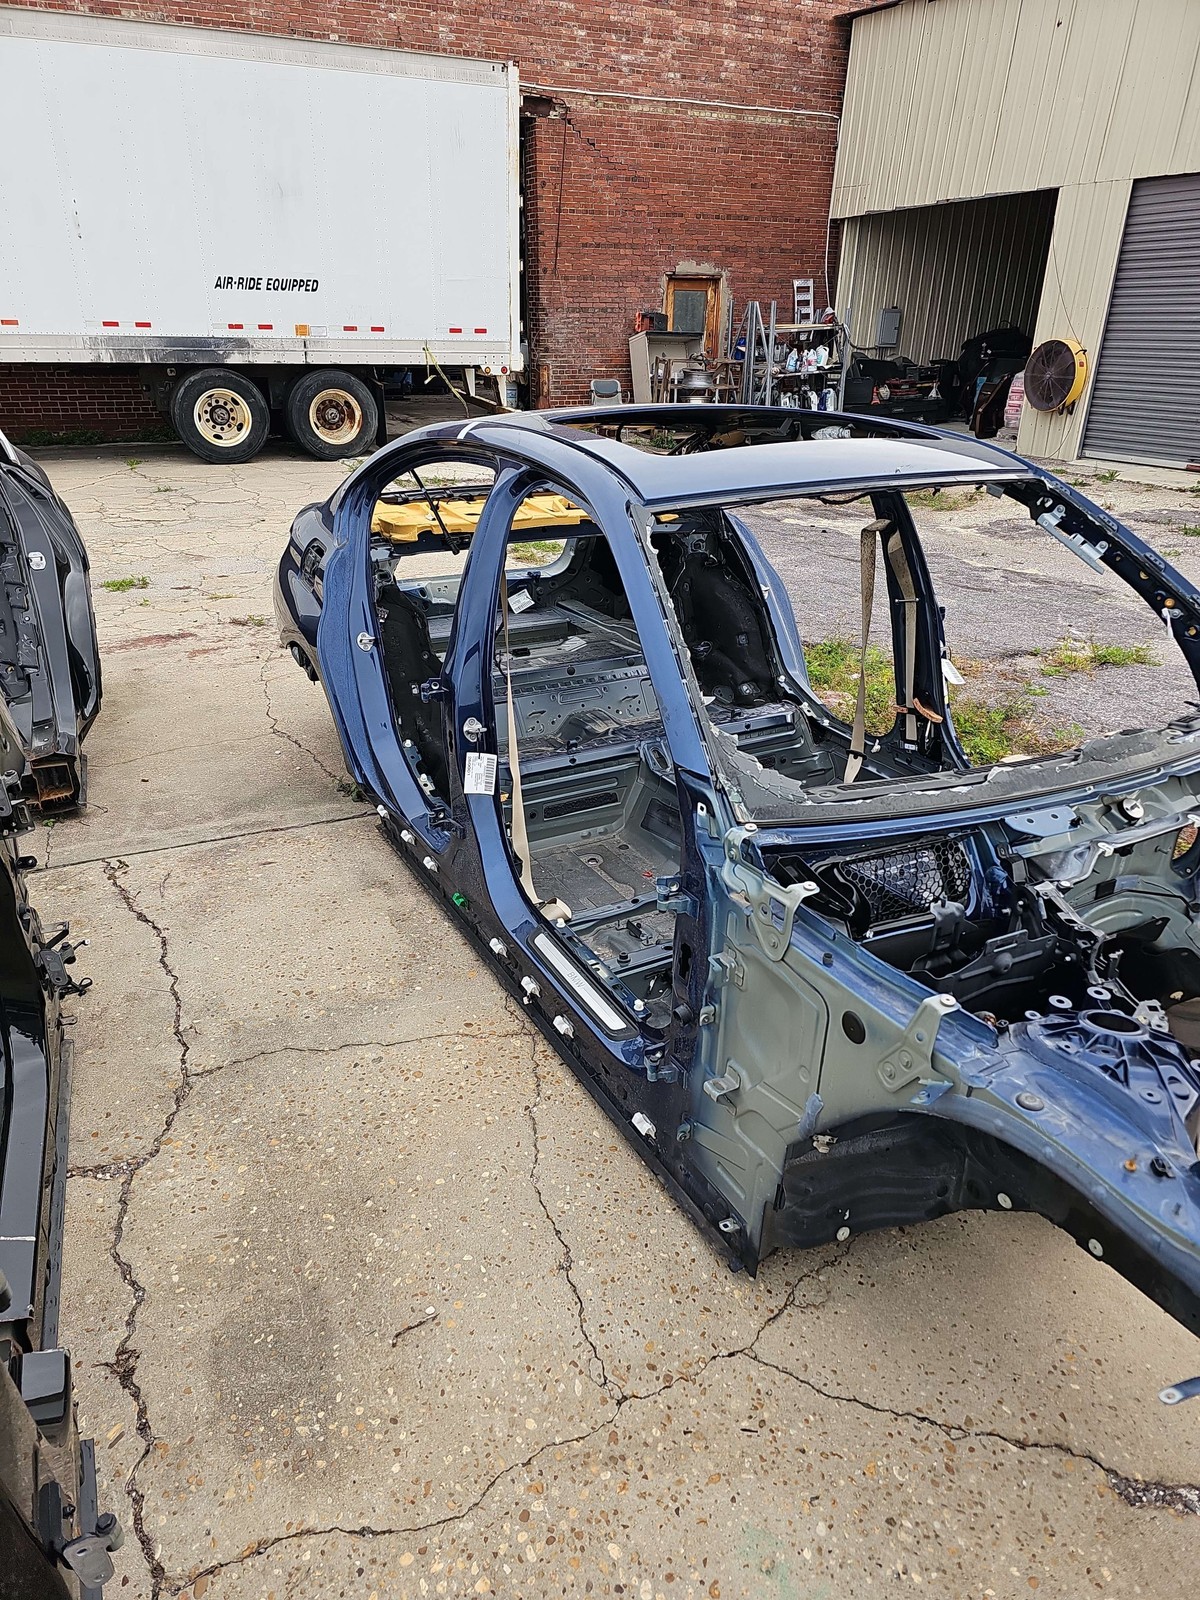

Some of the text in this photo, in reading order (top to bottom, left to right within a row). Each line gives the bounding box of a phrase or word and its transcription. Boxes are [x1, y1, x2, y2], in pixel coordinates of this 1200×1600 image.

[214, 276, 319, 292] AIR-RIDE EQUIPPED
[568, 971, 585, 988] BMW
